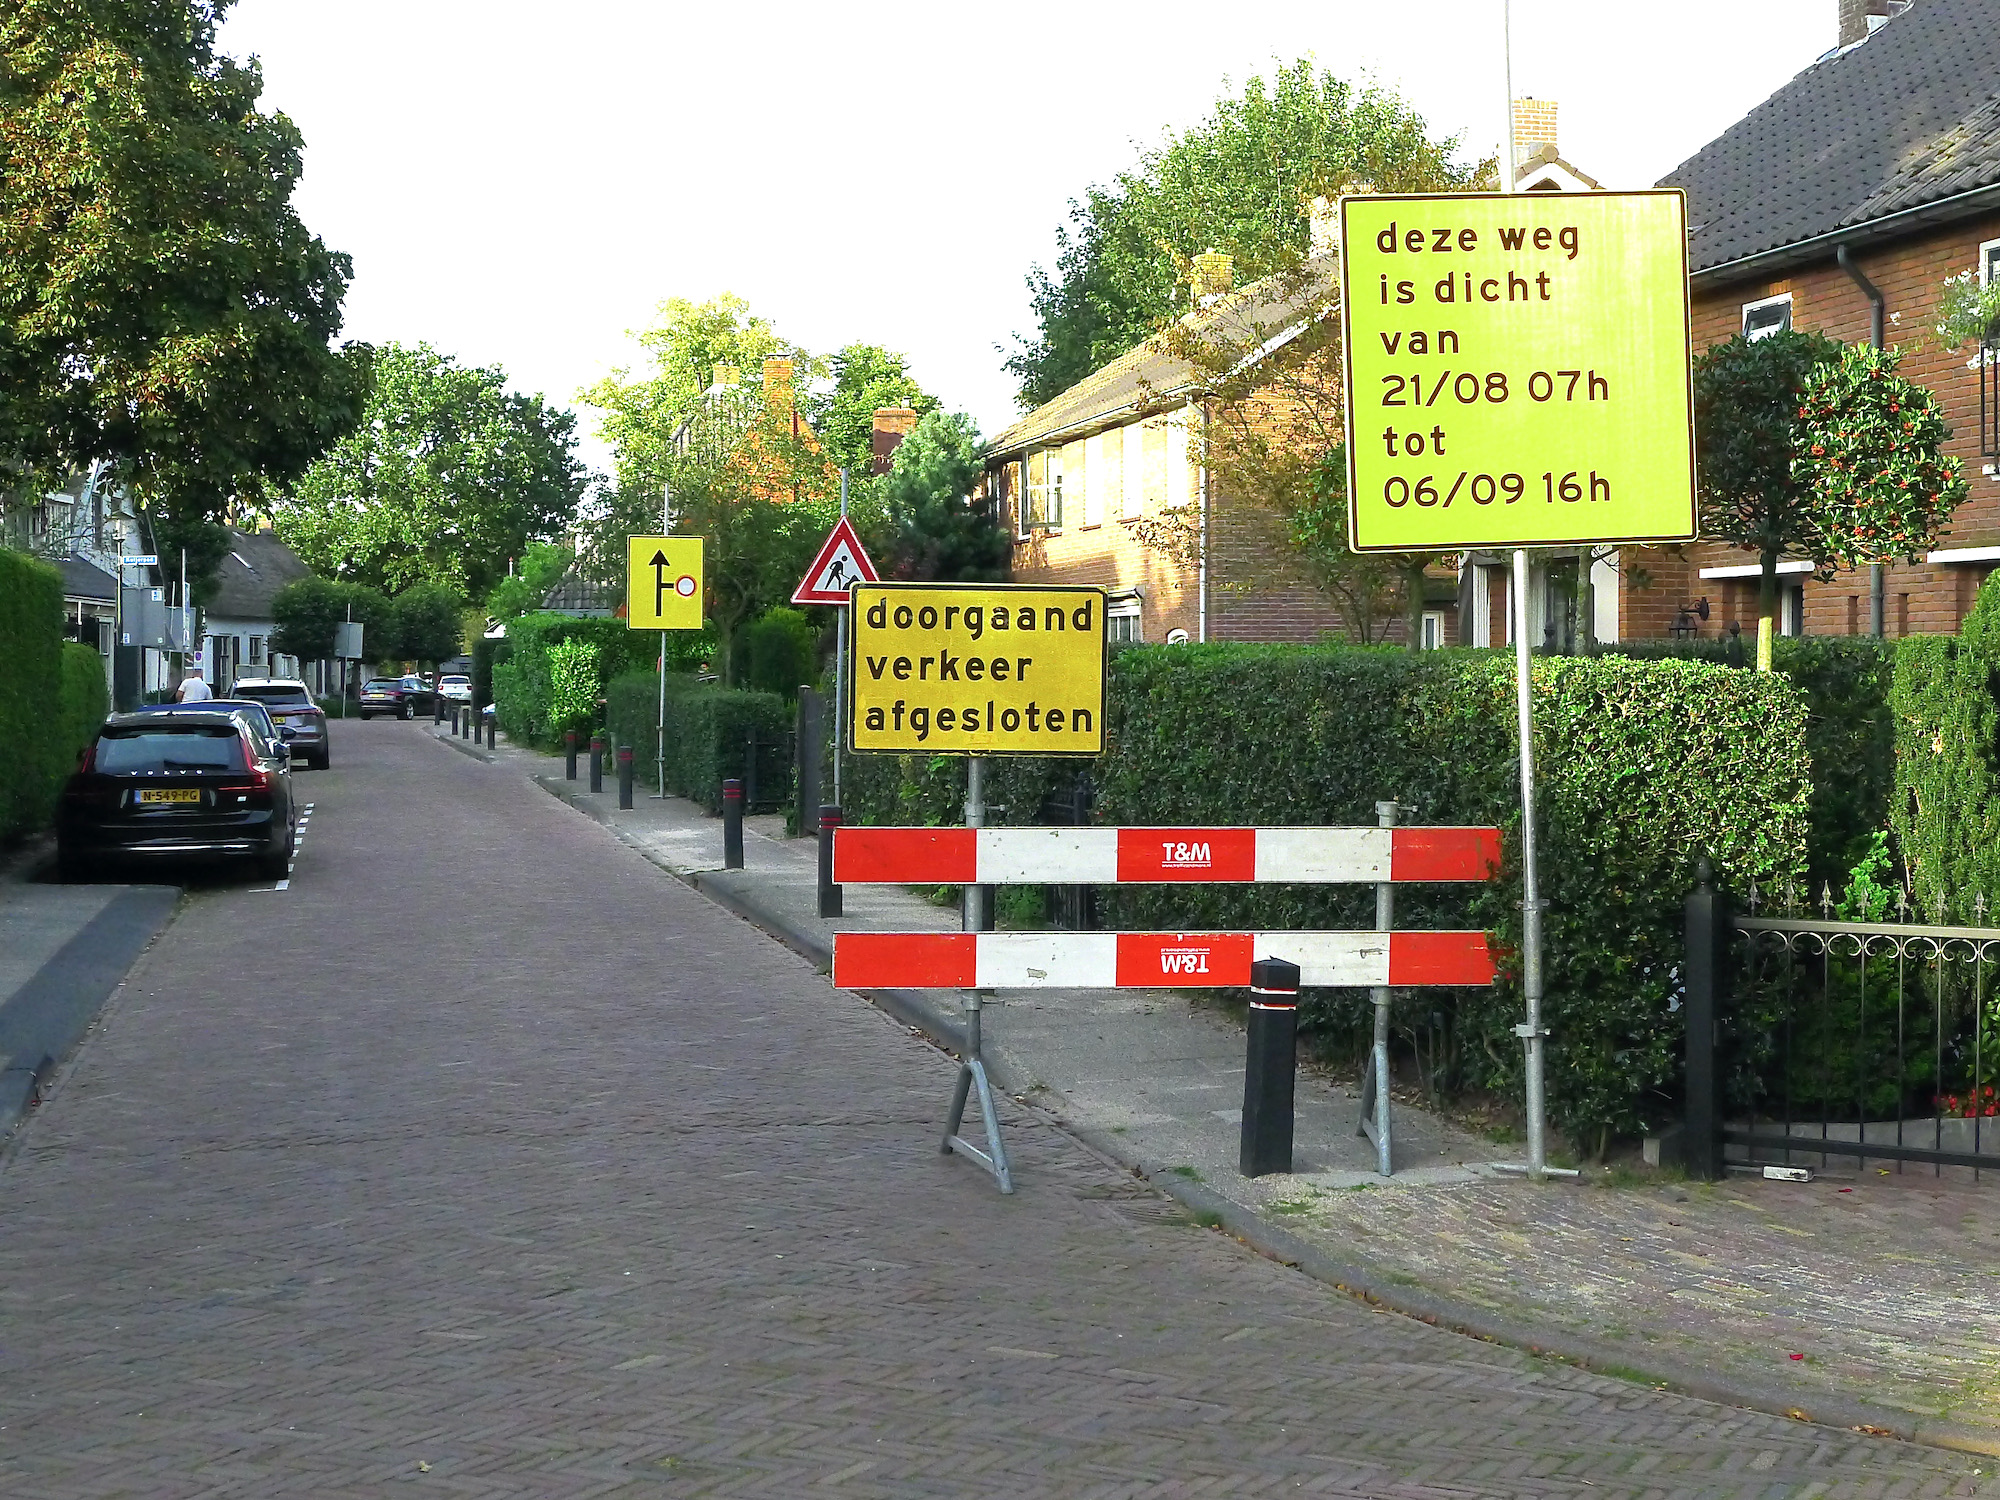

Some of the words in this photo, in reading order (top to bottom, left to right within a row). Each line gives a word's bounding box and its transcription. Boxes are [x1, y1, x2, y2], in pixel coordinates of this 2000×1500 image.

[1376, 221, 1478, 253] deze
[1498, 226, 1579, 260] weg
[1380, 273, 1415, 304] is
[1434, 271, 1551, 302] dicht
[1380, 330, 1459, 355] van
[1381, 371, 1509, 406] 21/08
[1528, 370, 1608, 401] 07h
[1382, 425, 1446, 456] tot
[1384, 472, 1525, 508] 06/09
[1543, 471, 1610, 502] 16h
[866, 597, 1092, 640] doorgaand
[866, 649, 1033, 681] verkeer
[865, 700, 1092, 741] afgesloten
[143, 790, 197, 801] N-549-PG
[1162, 842, 1211, 861] T&M
[1161, 955, 1210, 973] T&M
